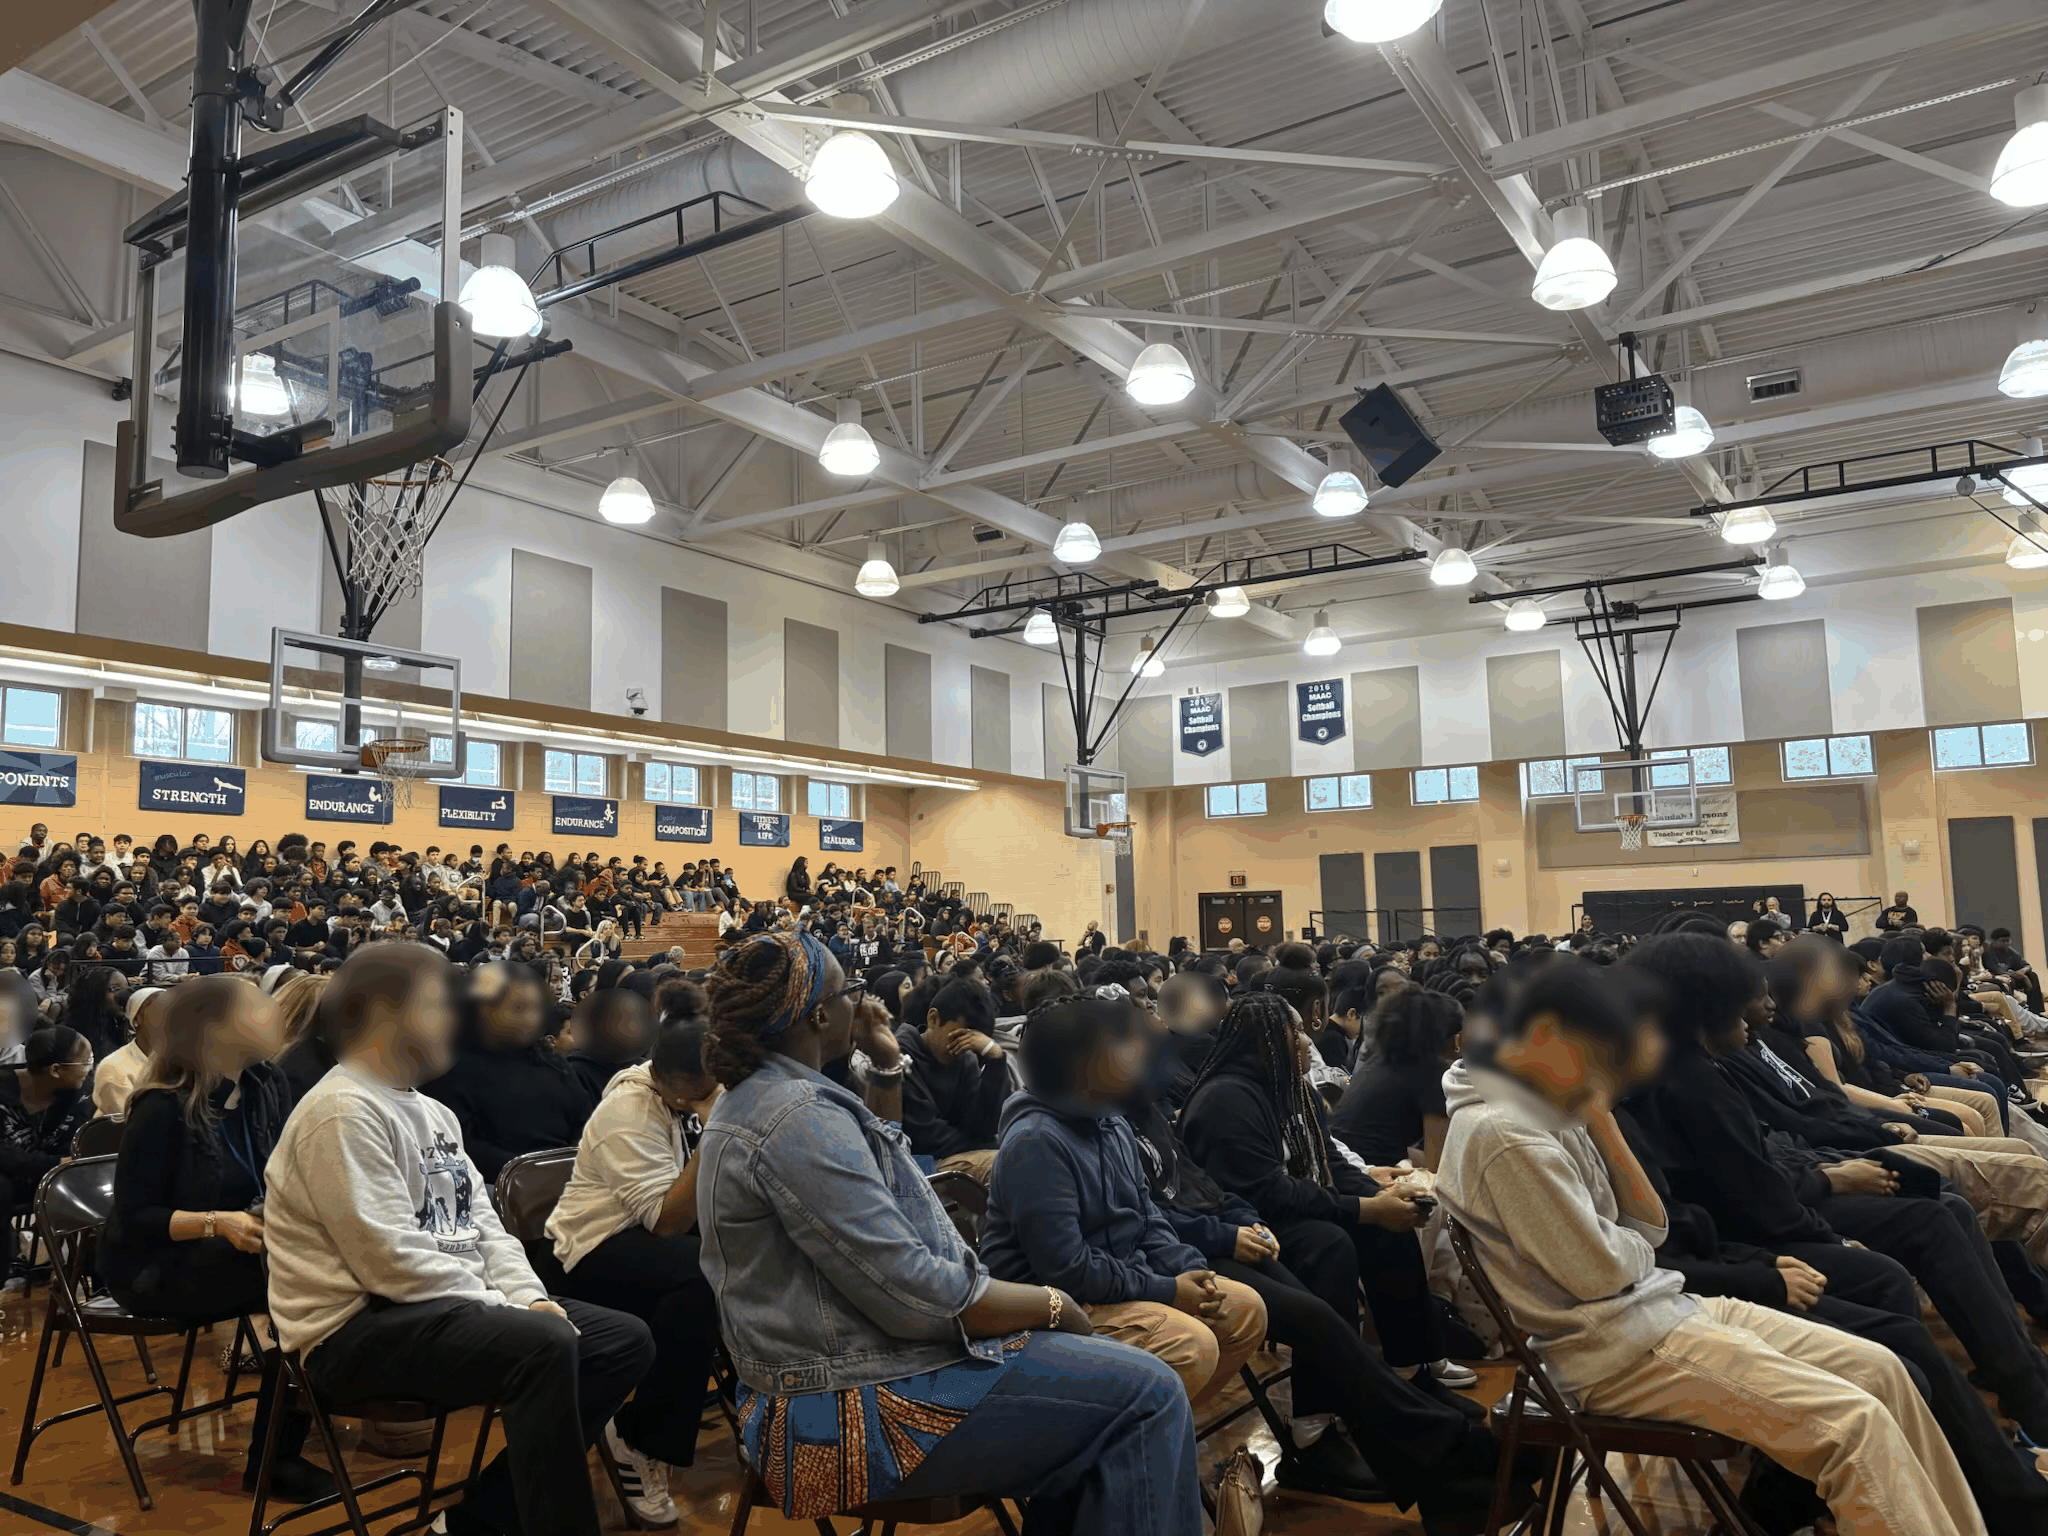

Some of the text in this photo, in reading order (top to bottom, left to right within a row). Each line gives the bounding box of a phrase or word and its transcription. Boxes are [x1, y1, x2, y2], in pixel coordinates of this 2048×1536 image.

[1308, 684, 1330, 693] 2016
[1309, 692, 1332, 701] MAAC
[1307, 701, 1335, 712] Softball
[1188, 714, 1213, 724] Softball
[1302, 711, 1341, 722] Champions
[1183, 724, 1220, 734] Champions
[152, 788, 227, 805] STRENGTH
[308, 799, 375, 814] ENDURANCE
[441, 808, 497, 822] FLEXIBILITY
[752, 815, 779, 825] FITNESS
[555, 816, 605, 829] ENDURANCE
[758, 823, 772, 831] FOR
[657, 825, 708, 837] COMPOSITION
[757, 831, 773, 840] LIFE
[1653, 830, 1684, 838] Teacher
[823, 836, 856, 846] STALLIONS
